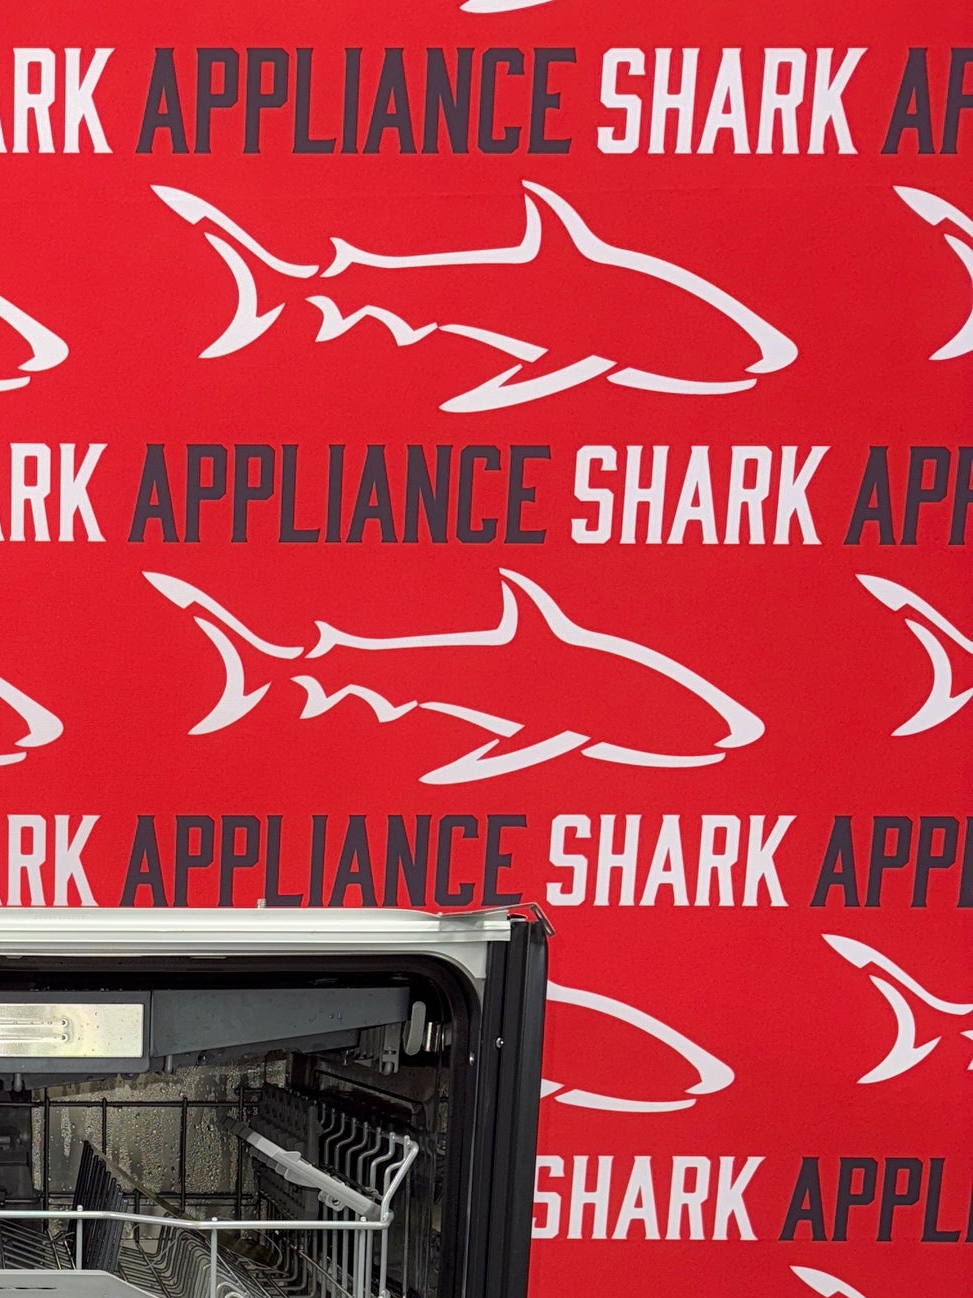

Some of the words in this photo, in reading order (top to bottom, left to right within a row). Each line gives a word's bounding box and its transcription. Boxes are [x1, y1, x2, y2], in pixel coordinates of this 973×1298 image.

[136, 47, 576, 154] APPLIANCE
[598, 48, 867, 155] SHARK
[129, 445, 550, 543] APPLIANCE
[572, 446, 830, 545] SHARK
[120, 815, 527, 907] APPLIANCE
[547, 815, 796, 907] SHARK
[530, 1155, 765, 1241] SHARK
[779, 1157, 973, 1243] APPL
